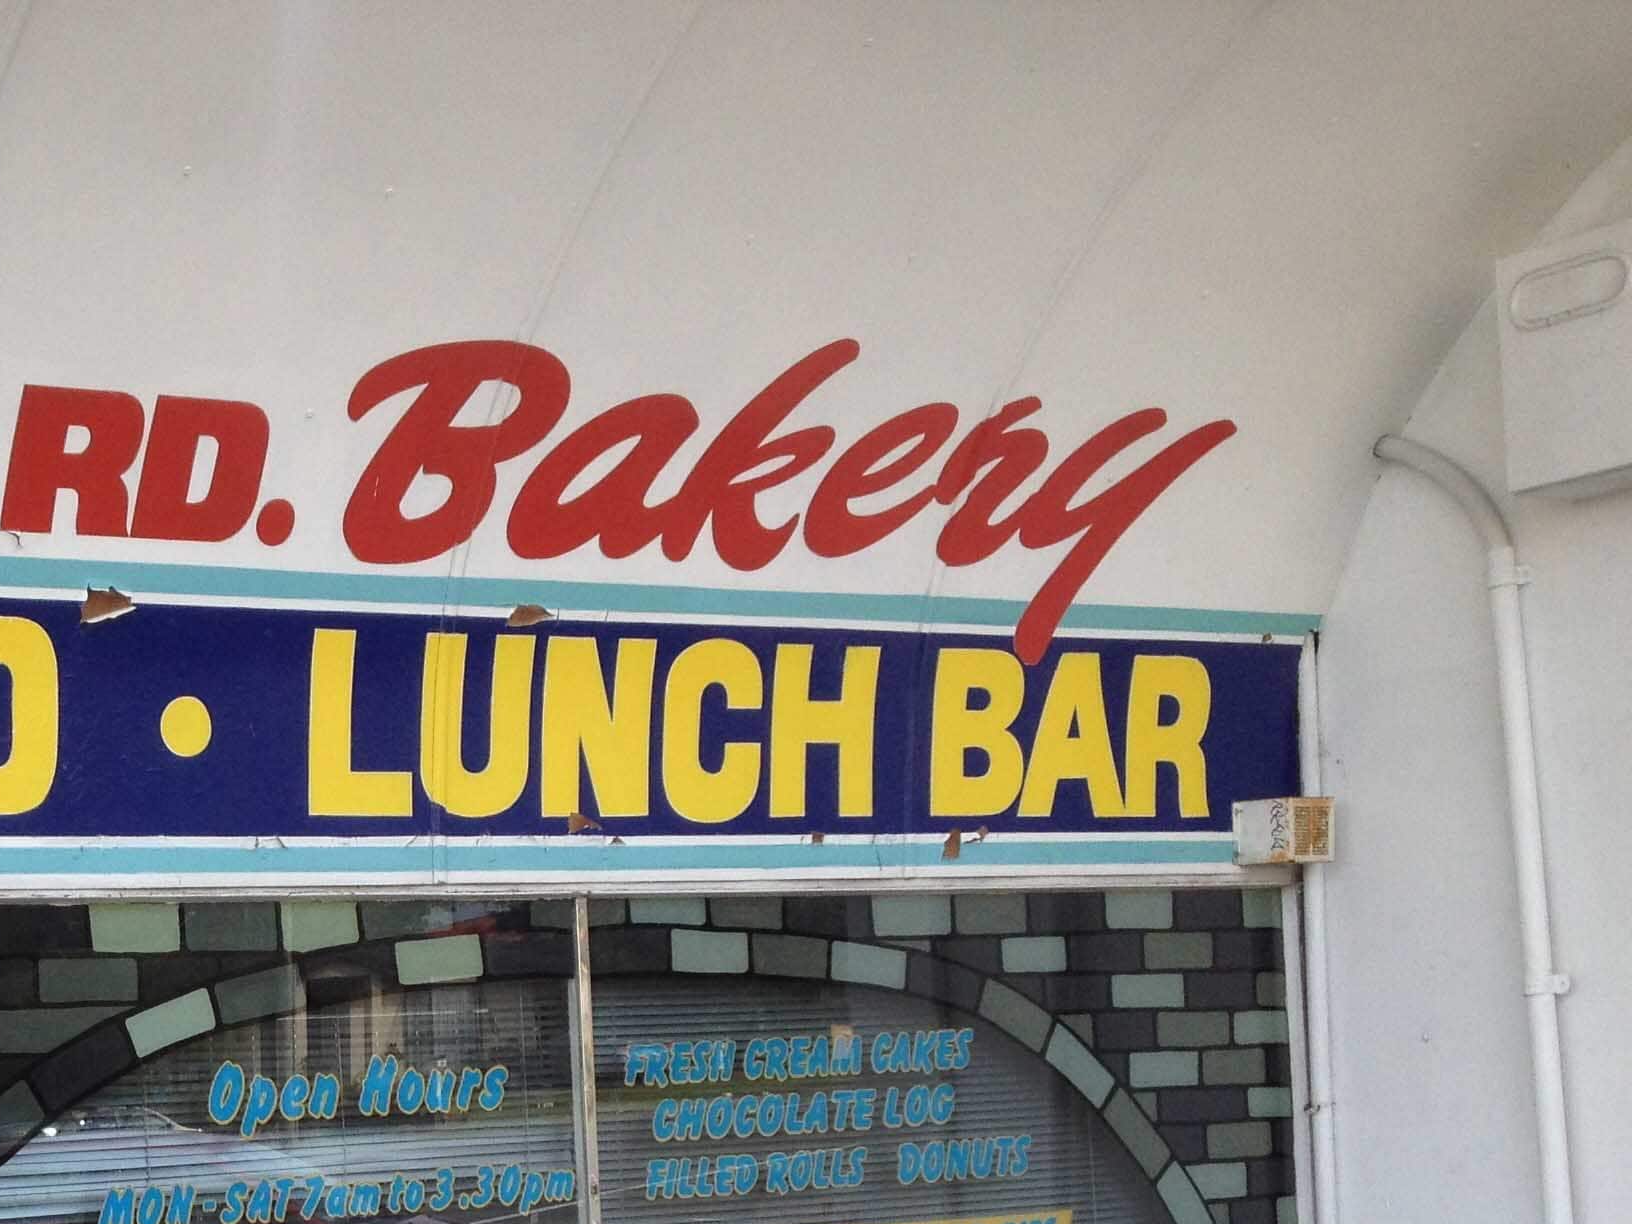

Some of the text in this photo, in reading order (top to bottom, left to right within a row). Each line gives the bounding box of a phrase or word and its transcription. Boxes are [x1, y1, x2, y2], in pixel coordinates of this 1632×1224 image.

[0, 384, 295, 546] RD.
[342, 339, 1237, 666] Bakery
[308, 628, 880, 823] LUNCH
[930, 647, 1212, 819] BAR
[624, 1028, 974, 1088] FRESH CREAM CAKES
[207, 1055, 509, 1138] Open Hours
[652, 1083, 957, 1142] CHOCOLATE LOG
[385, 1172, 425, 1214] to
[646, 1136, 1032, 1199] FILLED ROLLS DONUTS
